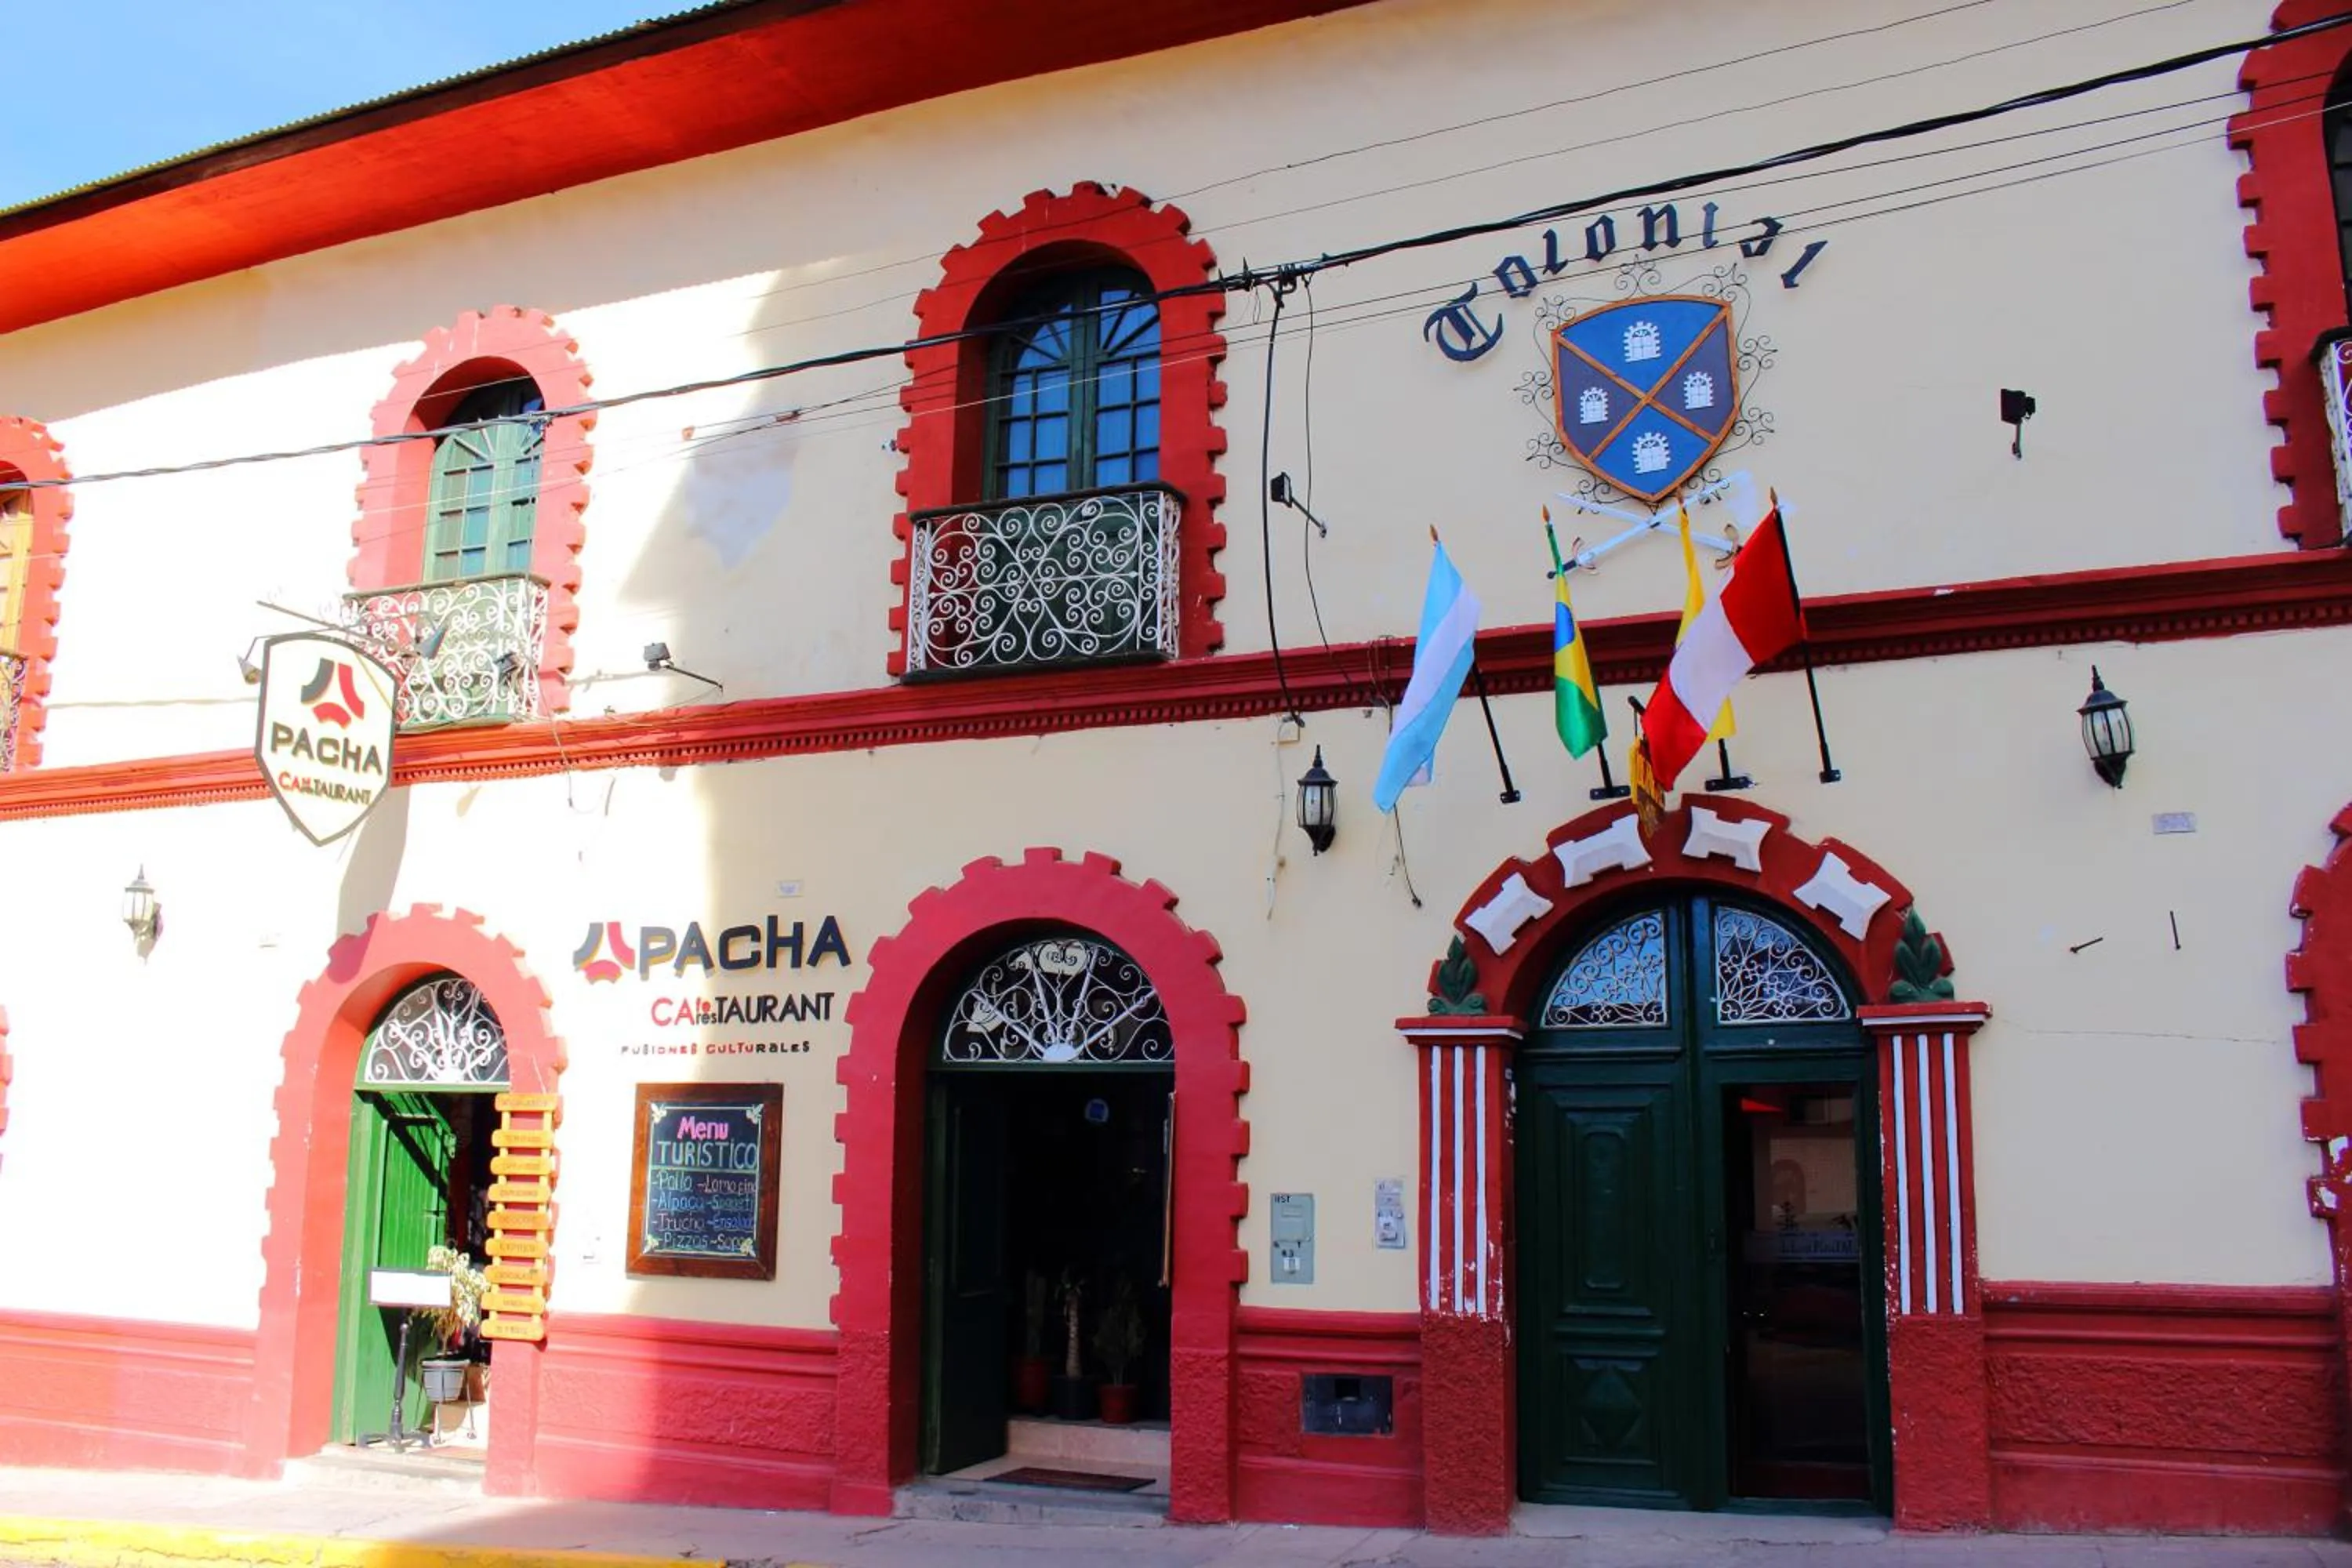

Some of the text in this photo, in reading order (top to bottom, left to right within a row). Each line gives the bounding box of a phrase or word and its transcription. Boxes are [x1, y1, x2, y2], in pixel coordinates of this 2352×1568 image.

[1423, 201, 1828, 363] Colonial
[270, 720, 383, 775] PACHA
[639, 915, 851, 979] PACHA
[621, 1041, 810, 1054] FUSIONES CULTURALES
[677, 1116, 728, 1140] Menu
